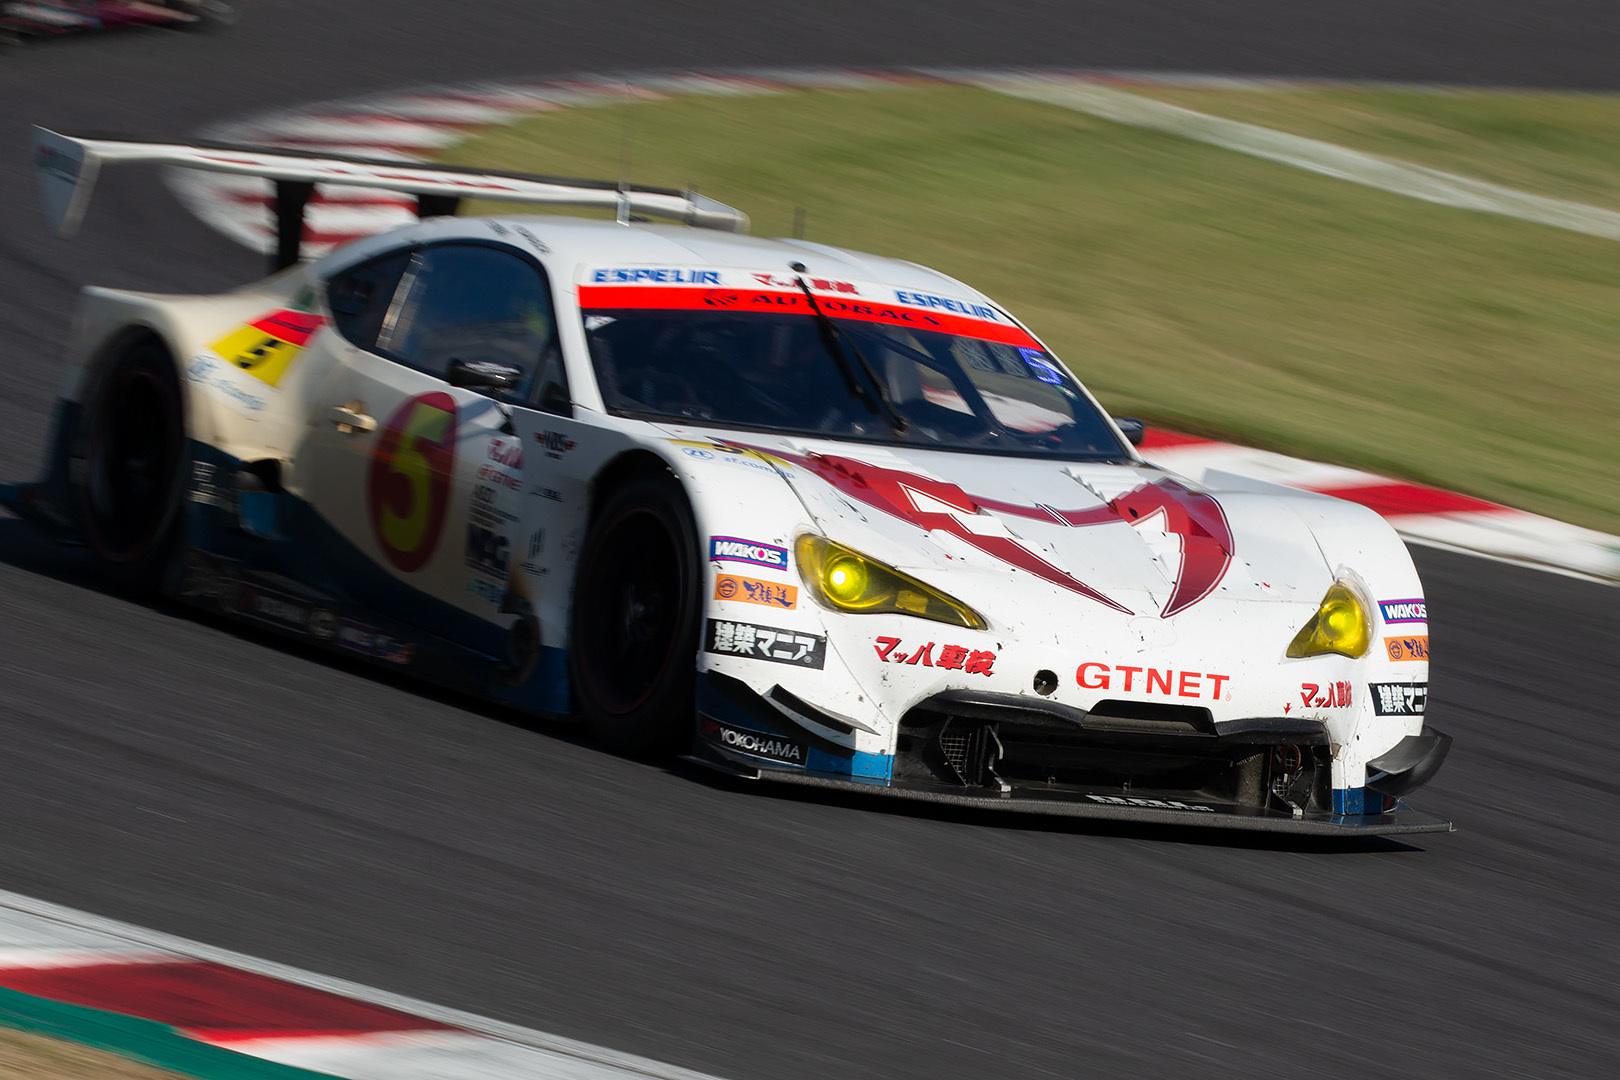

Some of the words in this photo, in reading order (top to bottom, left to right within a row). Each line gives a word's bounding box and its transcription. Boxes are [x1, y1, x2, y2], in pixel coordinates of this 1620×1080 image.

[594, 268, 722, 285] ESPELIR
[895, 290, 1001, 322] ESPELIR
[1018, 347, 1062, 385] 5
[380, 402, 456, 553] 5
[713, 621, 816, 661] 建築マニア
[873, 636, 996, 677] マッハ車検
[1075, 662, 1230, 701] GTNET
[720, 727, 800, 759] YOKOHAMA
